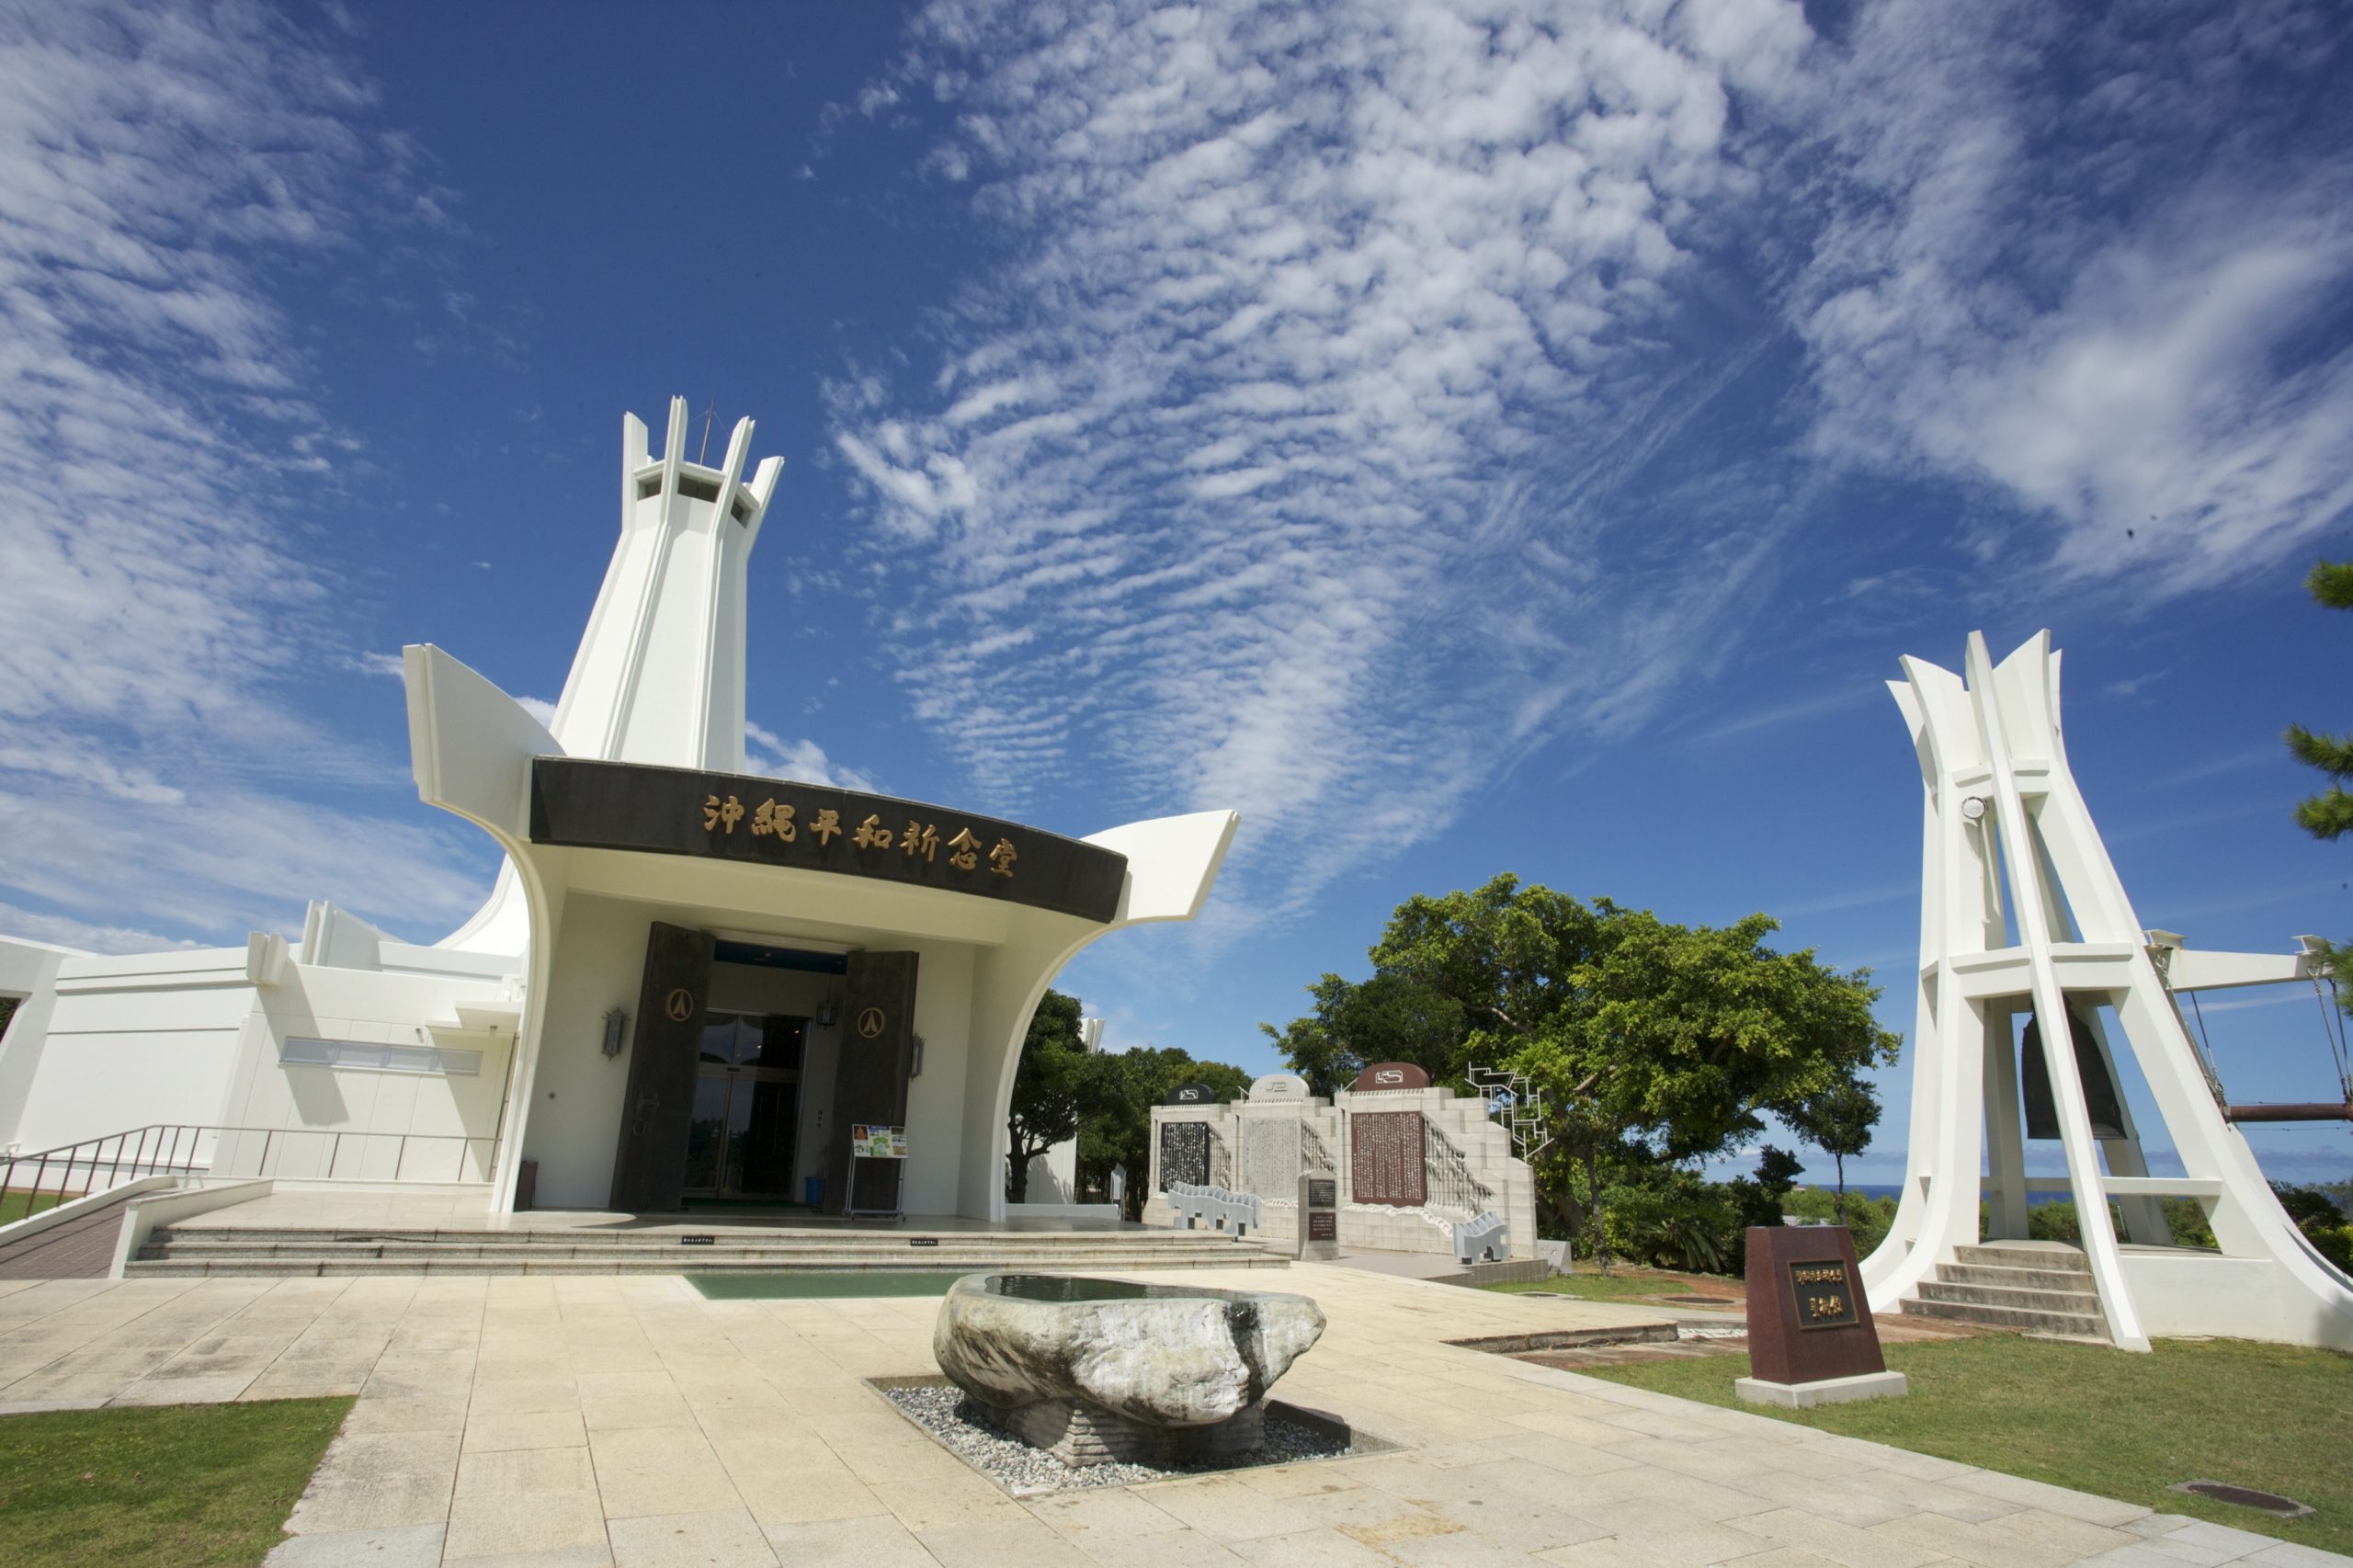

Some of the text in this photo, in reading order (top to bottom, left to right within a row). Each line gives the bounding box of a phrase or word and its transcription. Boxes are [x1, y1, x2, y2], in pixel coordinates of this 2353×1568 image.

[703, 794, 1017, 877] 沖縄平和祈念堂
